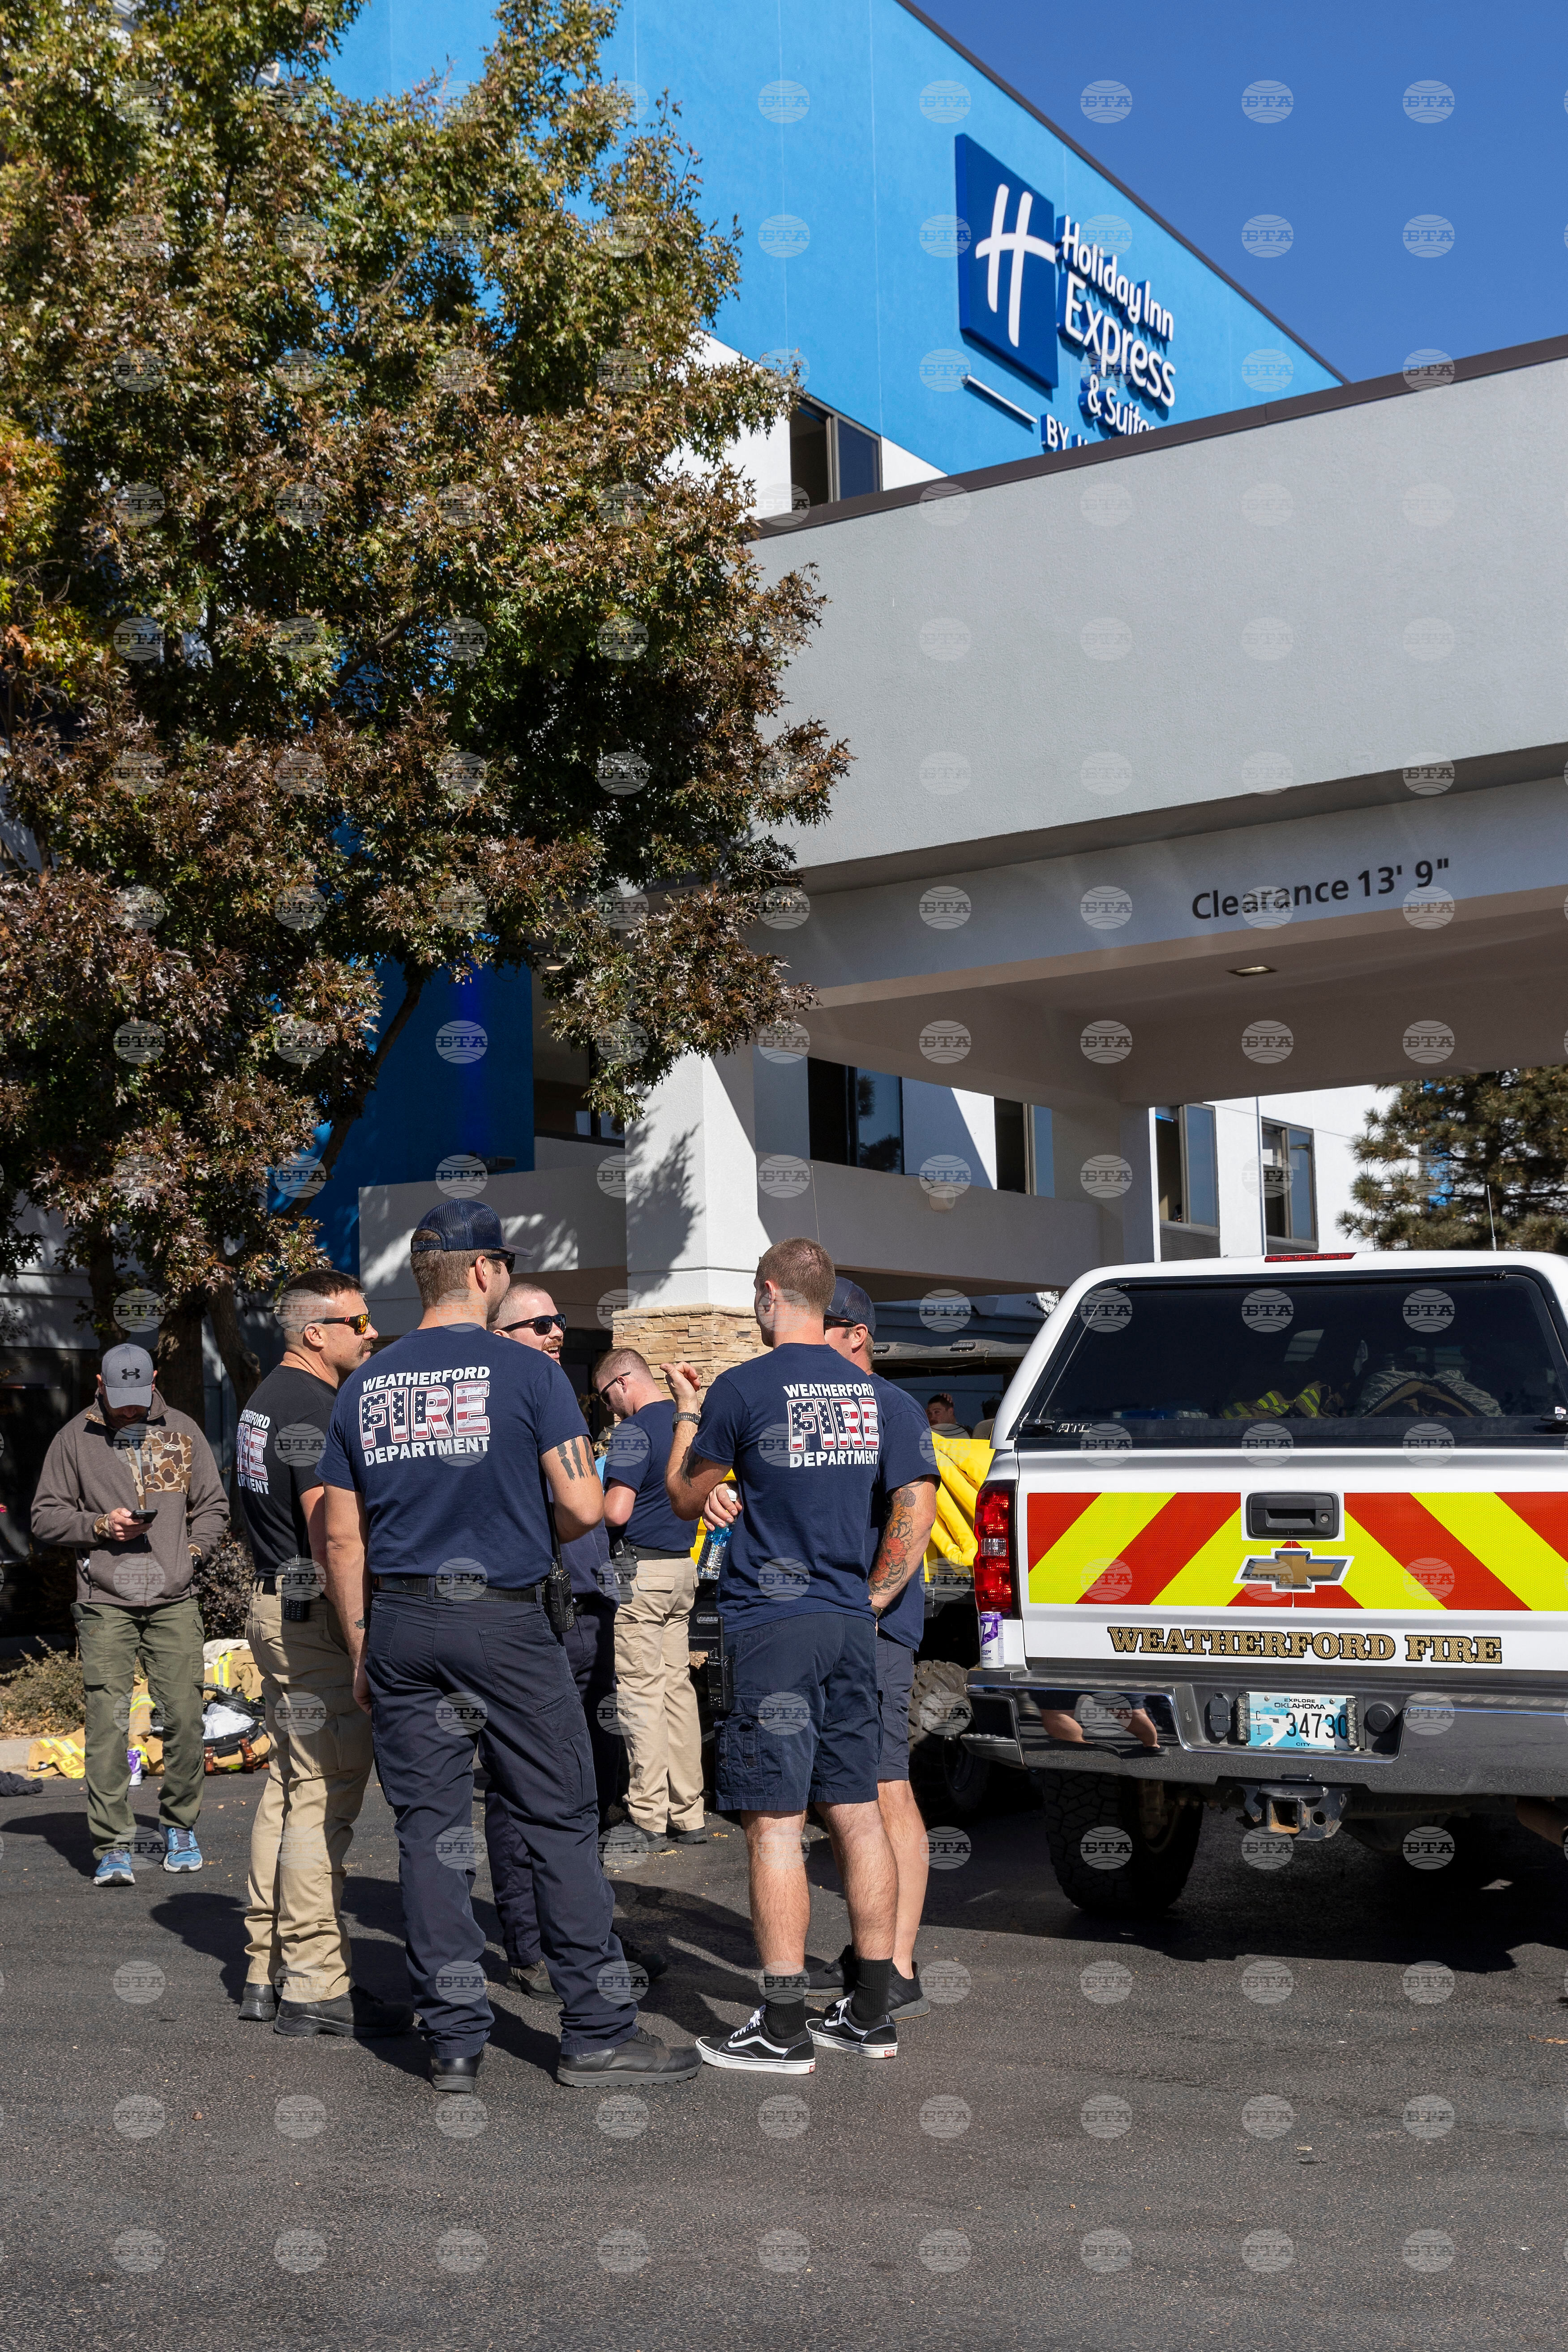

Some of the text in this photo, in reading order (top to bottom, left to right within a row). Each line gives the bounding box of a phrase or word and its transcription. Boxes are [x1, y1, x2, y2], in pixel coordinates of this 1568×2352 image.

[1062, 214, 1174, 342] Holiday Inn
[1065, 270, 1176, 408] Express
[1088, 374, 1157, 436] & Suite
[1047, 413, 1070, 450] BY
[1192, 858, 1450, 920] Clearance 13' 9"
[363, 1366, 490, 1393] WEATHERFORD
[783, 1383, 875, 1398] WEATHERFORD
[359, 1379, 491, 1451] FIRE
[786, 1397, 880, 1452] FIRE
[236, 1422, 269, 1481] IRE
[364, 1435, 490, 1467] DEPARTMENT
[789, 1450, 878, 1468] DEPARTMENT
[1107, 1626, 1504, 1665] WEATHERFORD FIRE
[1274, 1702, 1326, 1710] OKLAHOMA
[1285, 1712, 1348, 1739] 34730
